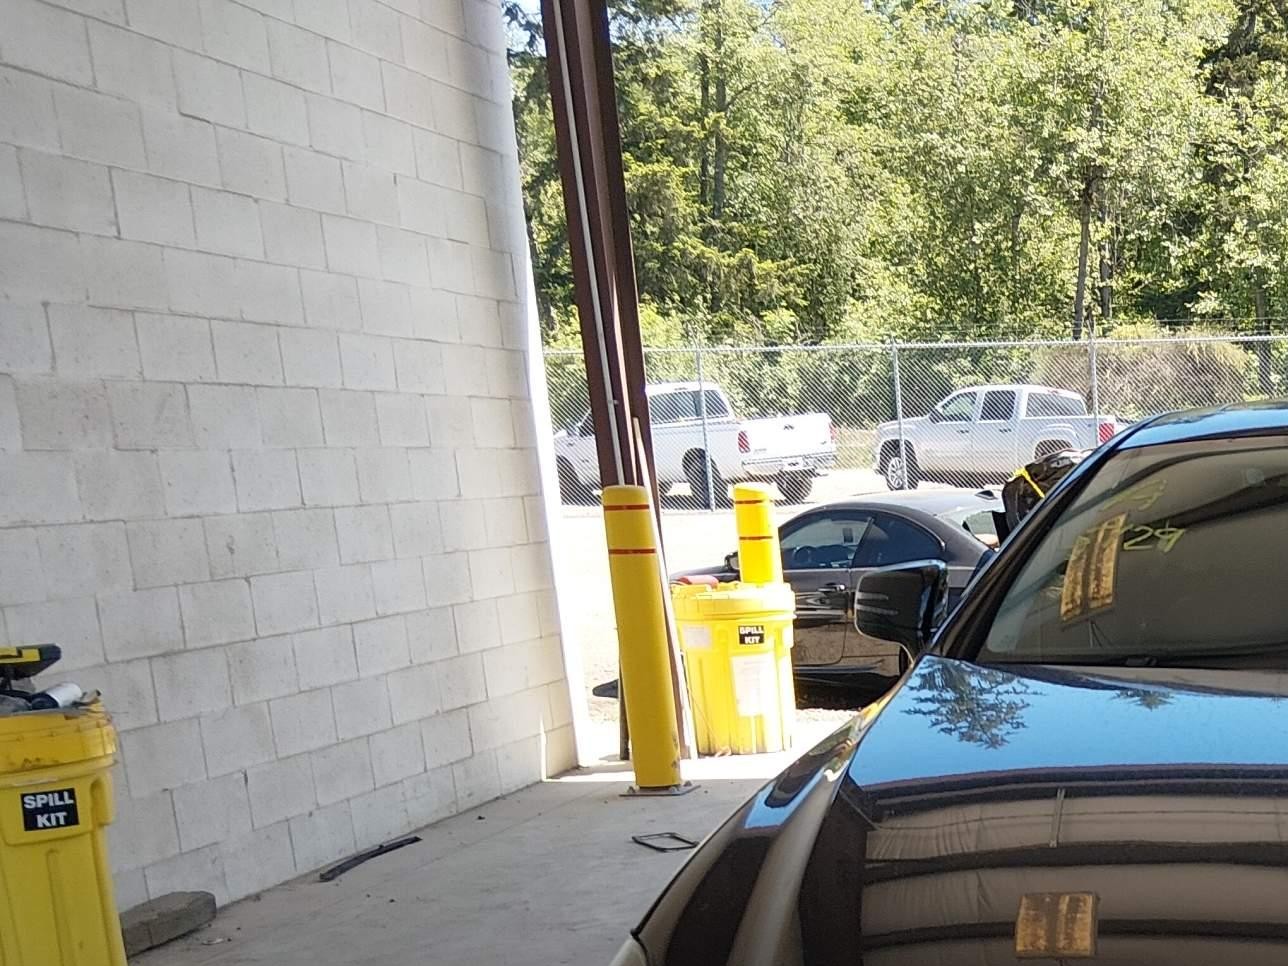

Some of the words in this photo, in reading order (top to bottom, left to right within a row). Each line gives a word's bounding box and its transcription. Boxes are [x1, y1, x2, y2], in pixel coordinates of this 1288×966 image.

[739, 626, 764, 635] SPILL
[744, 636, 761, 645] KIT
[23, 791, 74, 809] SPILL
[36, 811, 68, 828] KIT
